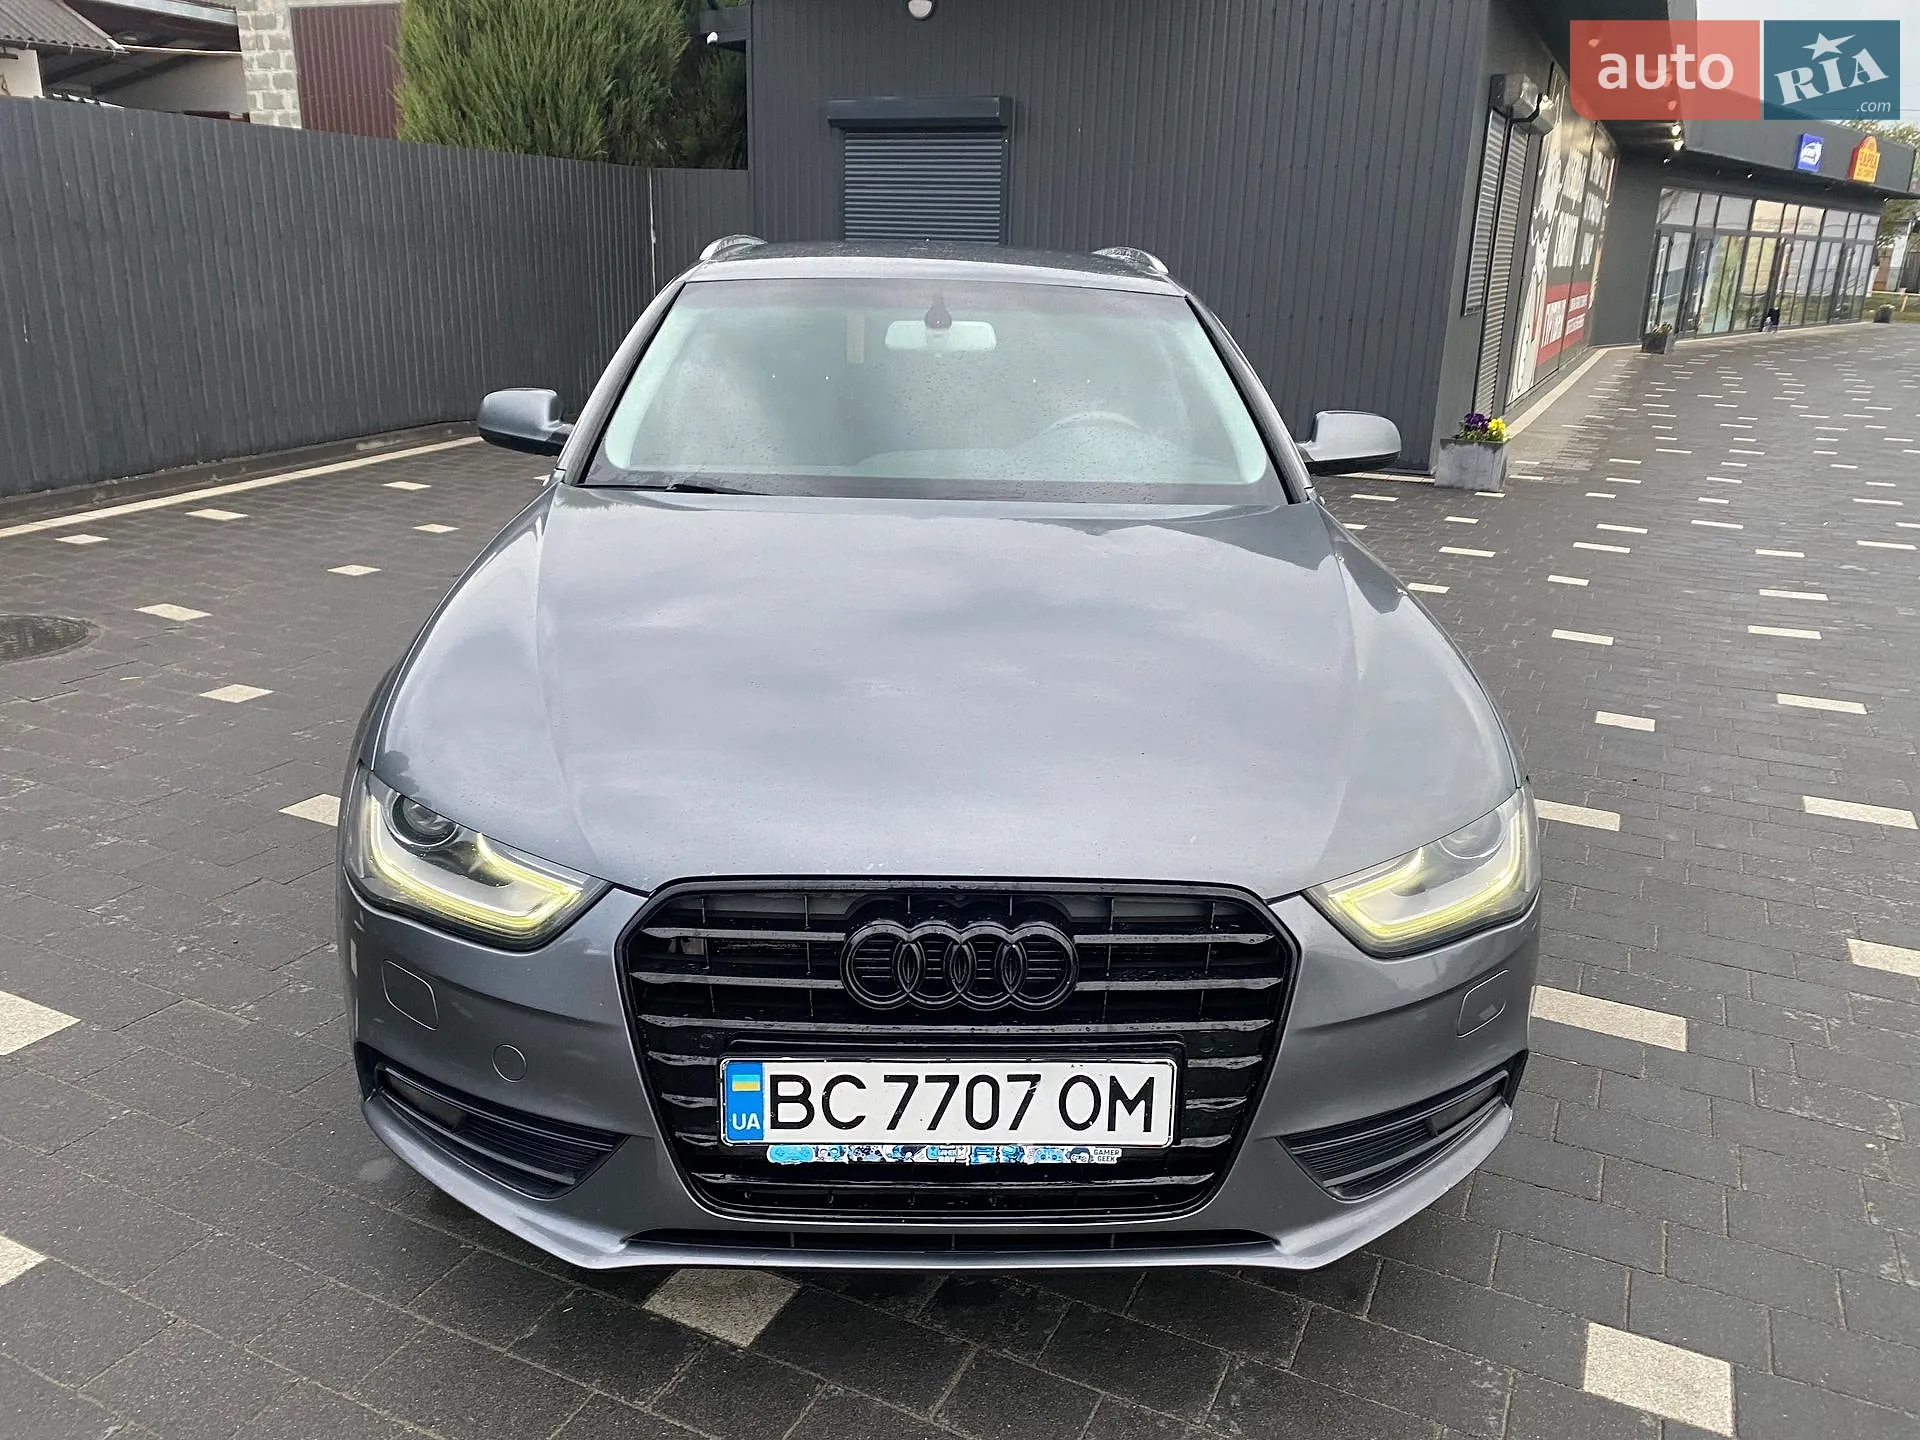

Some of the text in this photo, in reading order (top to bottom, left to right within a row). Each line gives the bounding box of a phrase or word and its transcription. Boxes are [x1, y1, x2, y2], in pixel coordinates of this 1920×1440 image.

[733, 1113, 760, 1130] UA
[769, 1074, 1154, 1132] BC 7707 OM
